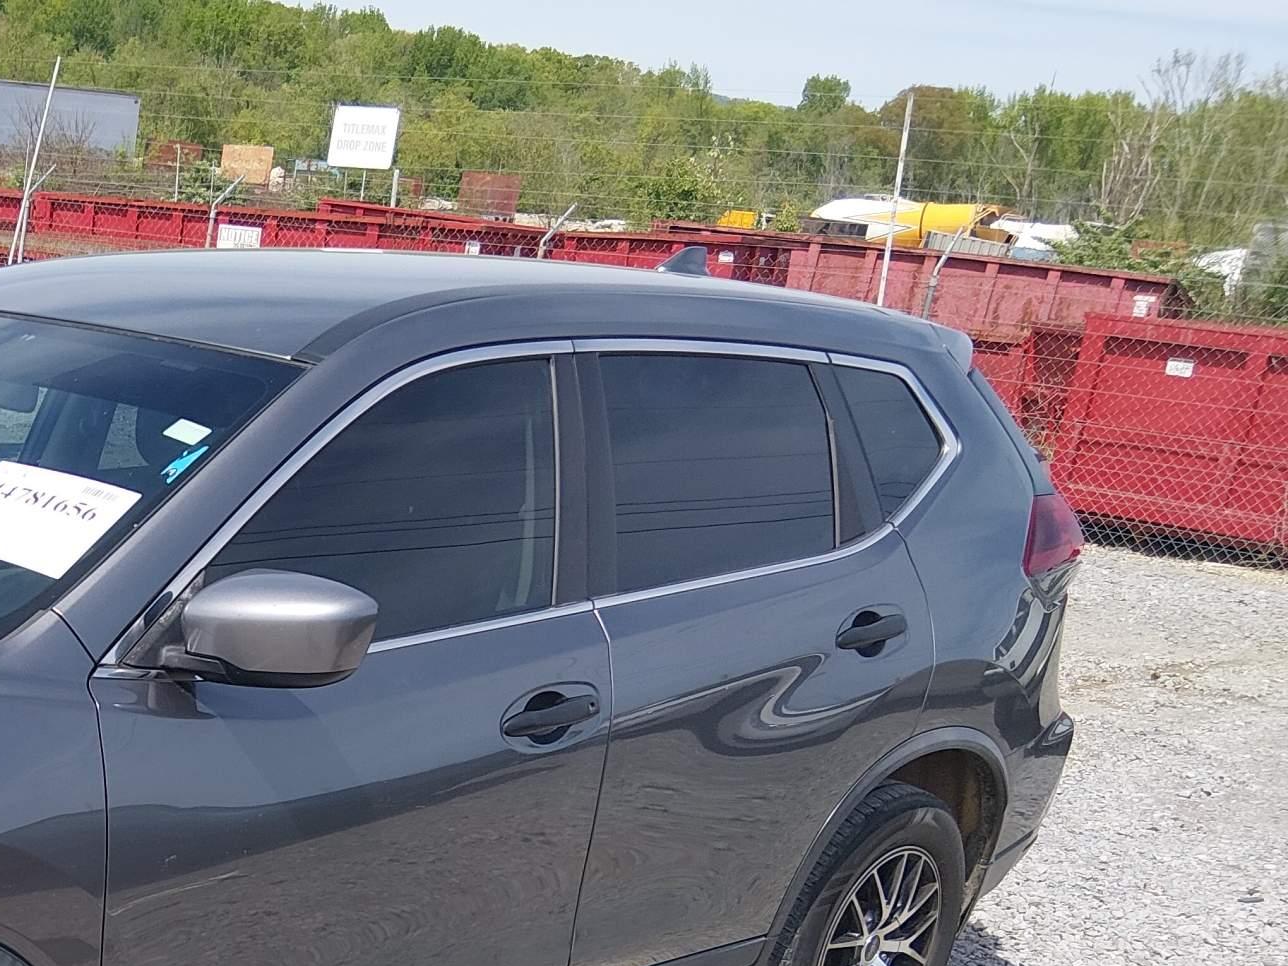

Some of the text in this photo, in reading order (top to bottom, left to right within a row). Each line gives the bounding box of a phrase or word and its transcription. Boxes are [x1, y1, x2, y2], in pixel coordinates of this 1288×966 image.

[343, 123, 387, 136] TITLEMAX
[336, 139, 387, 153] DROP ZONE
[220, 227, 259, 245] NOTICE
